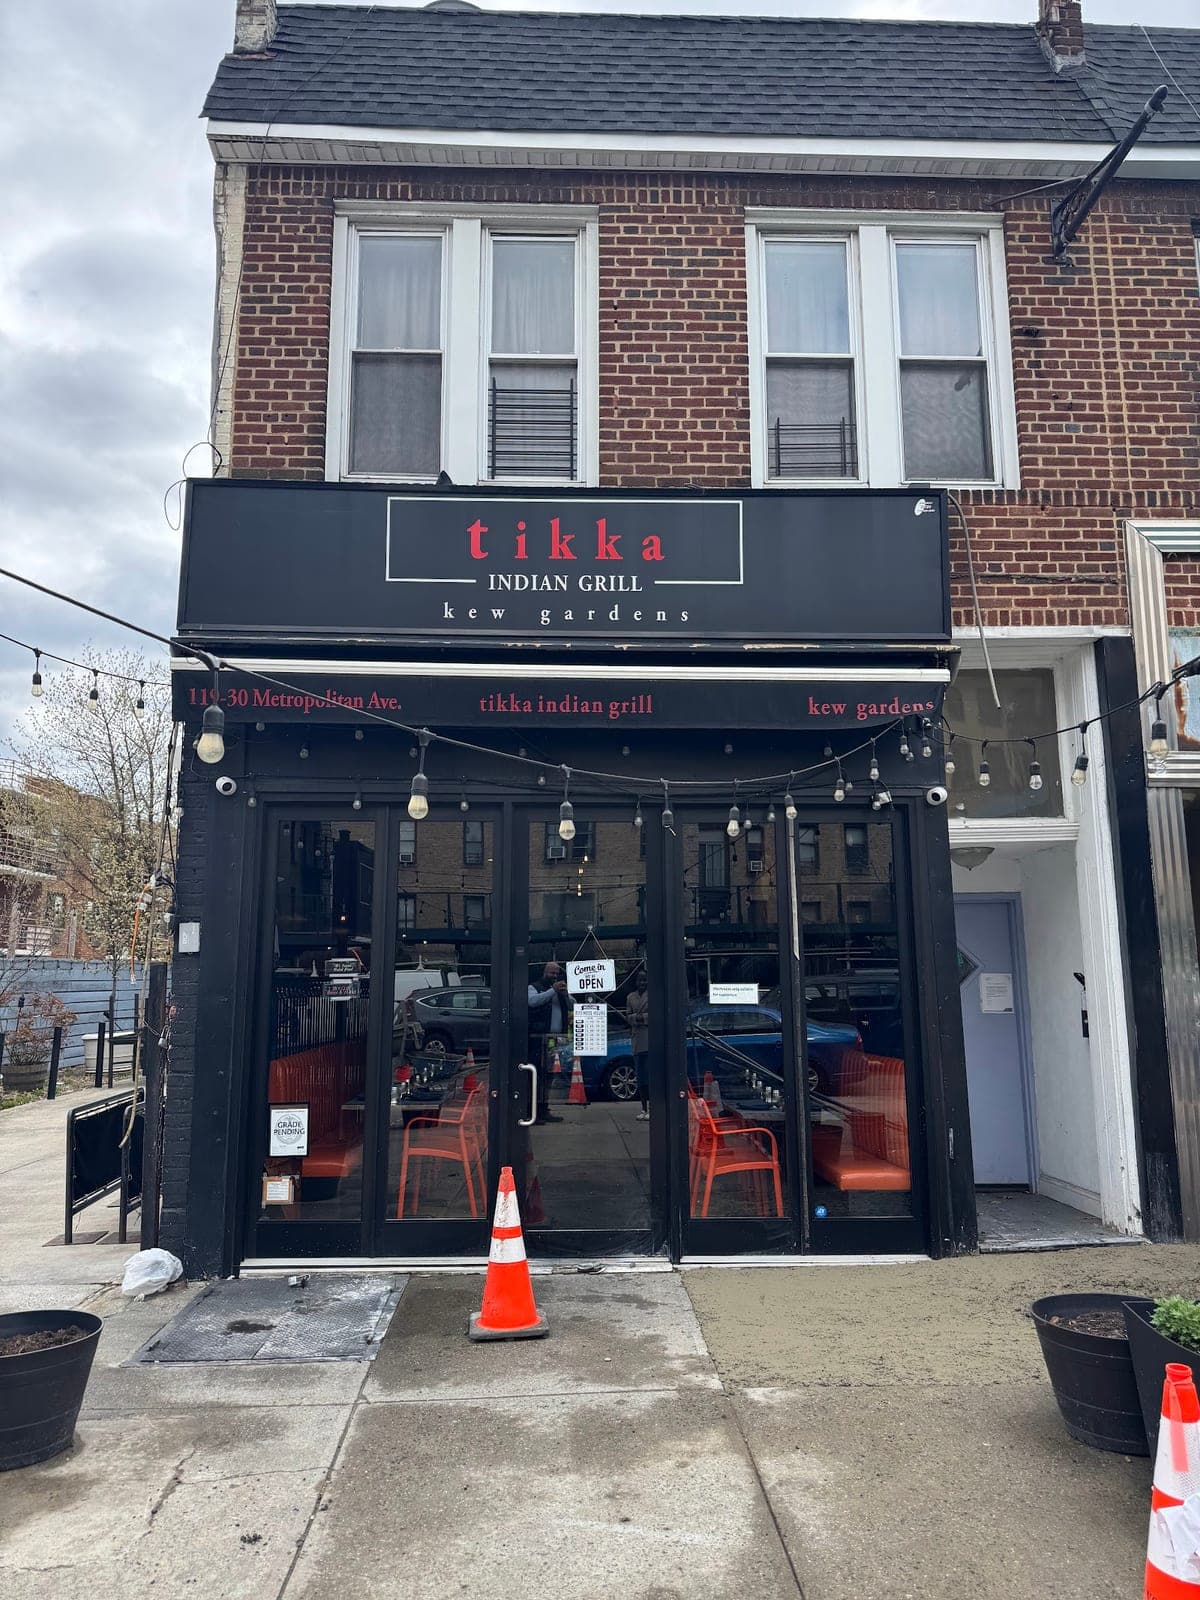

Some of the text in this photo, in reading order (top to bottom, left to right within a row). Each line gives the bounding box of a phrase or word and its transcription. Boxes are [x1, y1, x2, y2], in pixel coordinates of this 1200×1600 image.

[467, 518, 664, 561] tikka
[488, 573, 643, 592] INDIAN GRILL
[443, 602, 689, 626] kew gardens
[188, 687, 402, 714] 119-30 Metropolitan Ave.
[479, 693, 653, 720] tikka indian grill
[808, 697, 935, 721] kew gardens
[574, 963, 606, 976] Come in
[580, 978, 604, 990] OPEN
[273, 1128, 305, 1136] PENDING
[277, 1121, 302, 1129] GRADE
